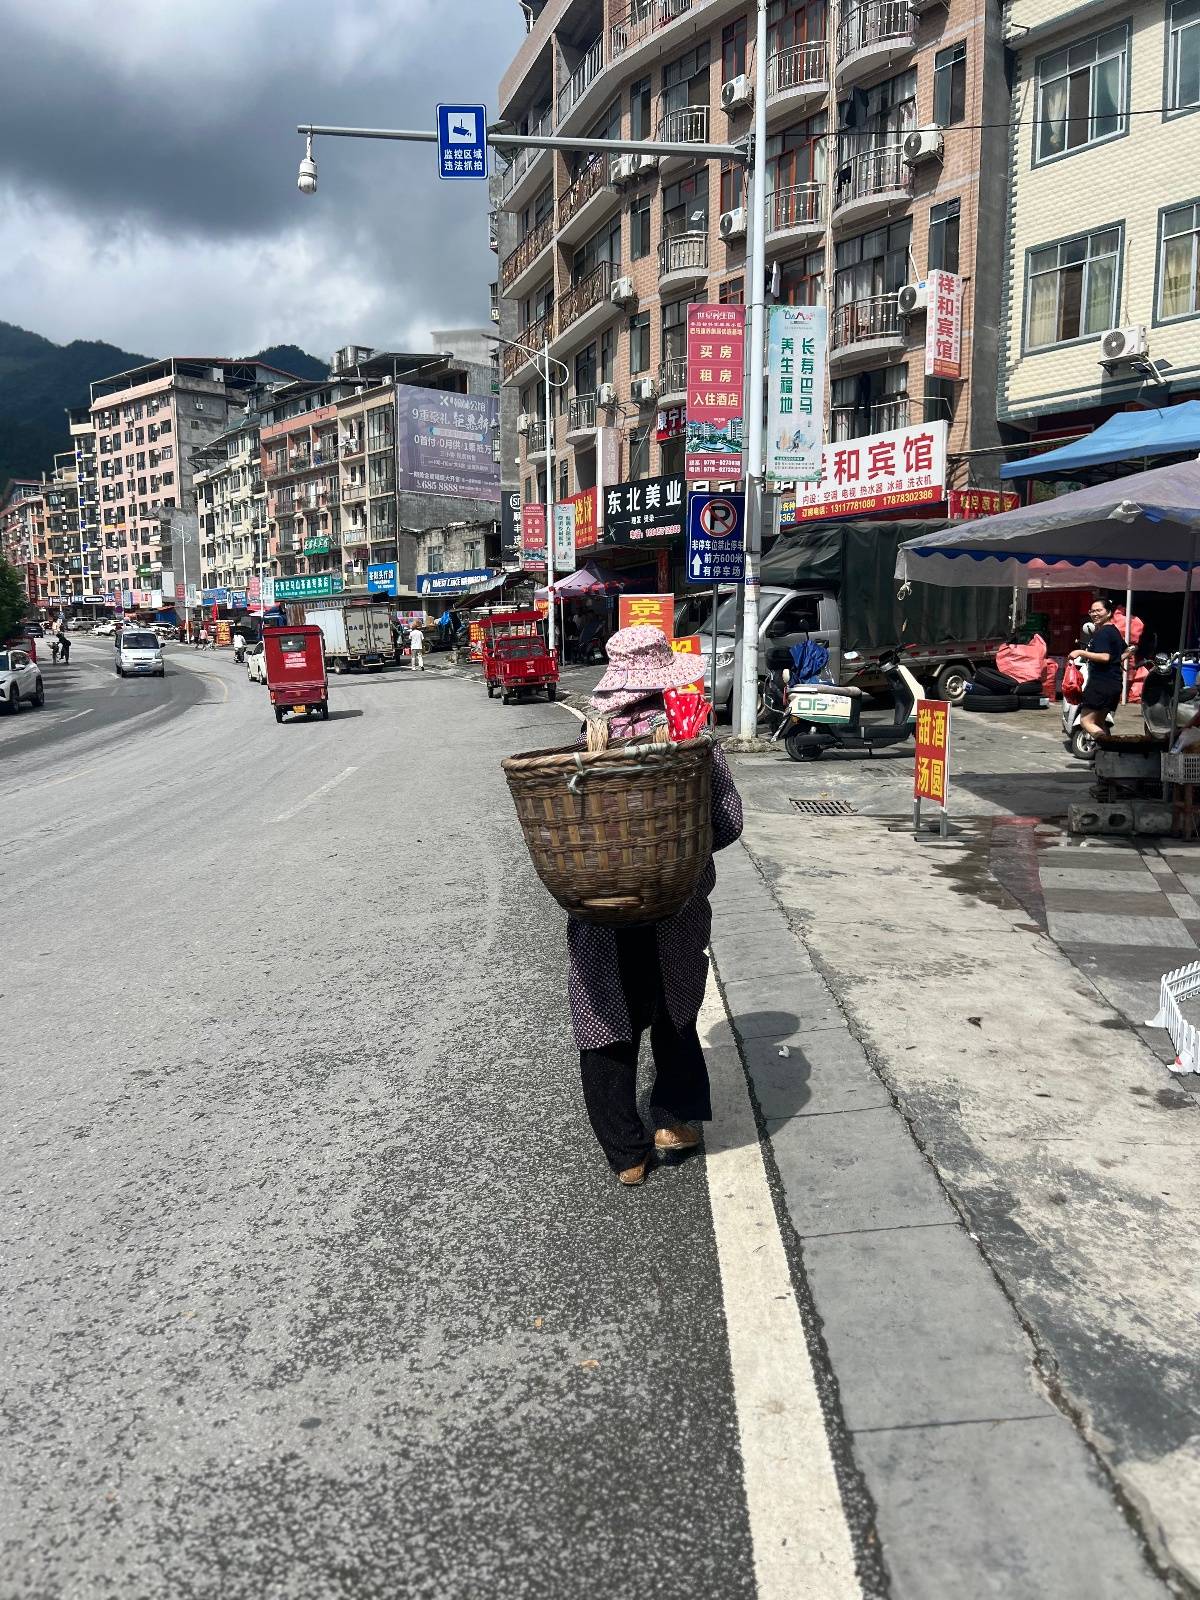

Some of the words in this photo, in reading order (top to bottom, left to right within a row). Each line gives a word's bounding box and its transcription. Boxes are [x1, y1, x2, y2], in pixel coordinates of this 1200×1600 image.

[444, 149, 483, 159] 监控区域
[444, 161, 483, 171] 违法抓拍
[937, 274, 955, 360] 祥和宾馆
[700, 345, 732, 358] 买房
[700, 369, 732, 382] 租房
[780, 338, 794, 414] 养生福地
[800, 338, 814, 415] 长寿巴马
[694, 393, 738, 406] 入住酒店
[907, 474, 932, 488] 洗衣机
[608, 480, 681, 514] 东北美业
[831, 500, 876, 513] 13117781080
[883, 489, 933, 505] 17878302386
[691, 540, 744, 550] 非停车位禁止停车
[703, 553, 743, 563] 前方600米
[703, 566, 741, 576] 有停车场
[919, 709, 945, 748] 甜酒
[918, 757, 943, 797] 汤圆
